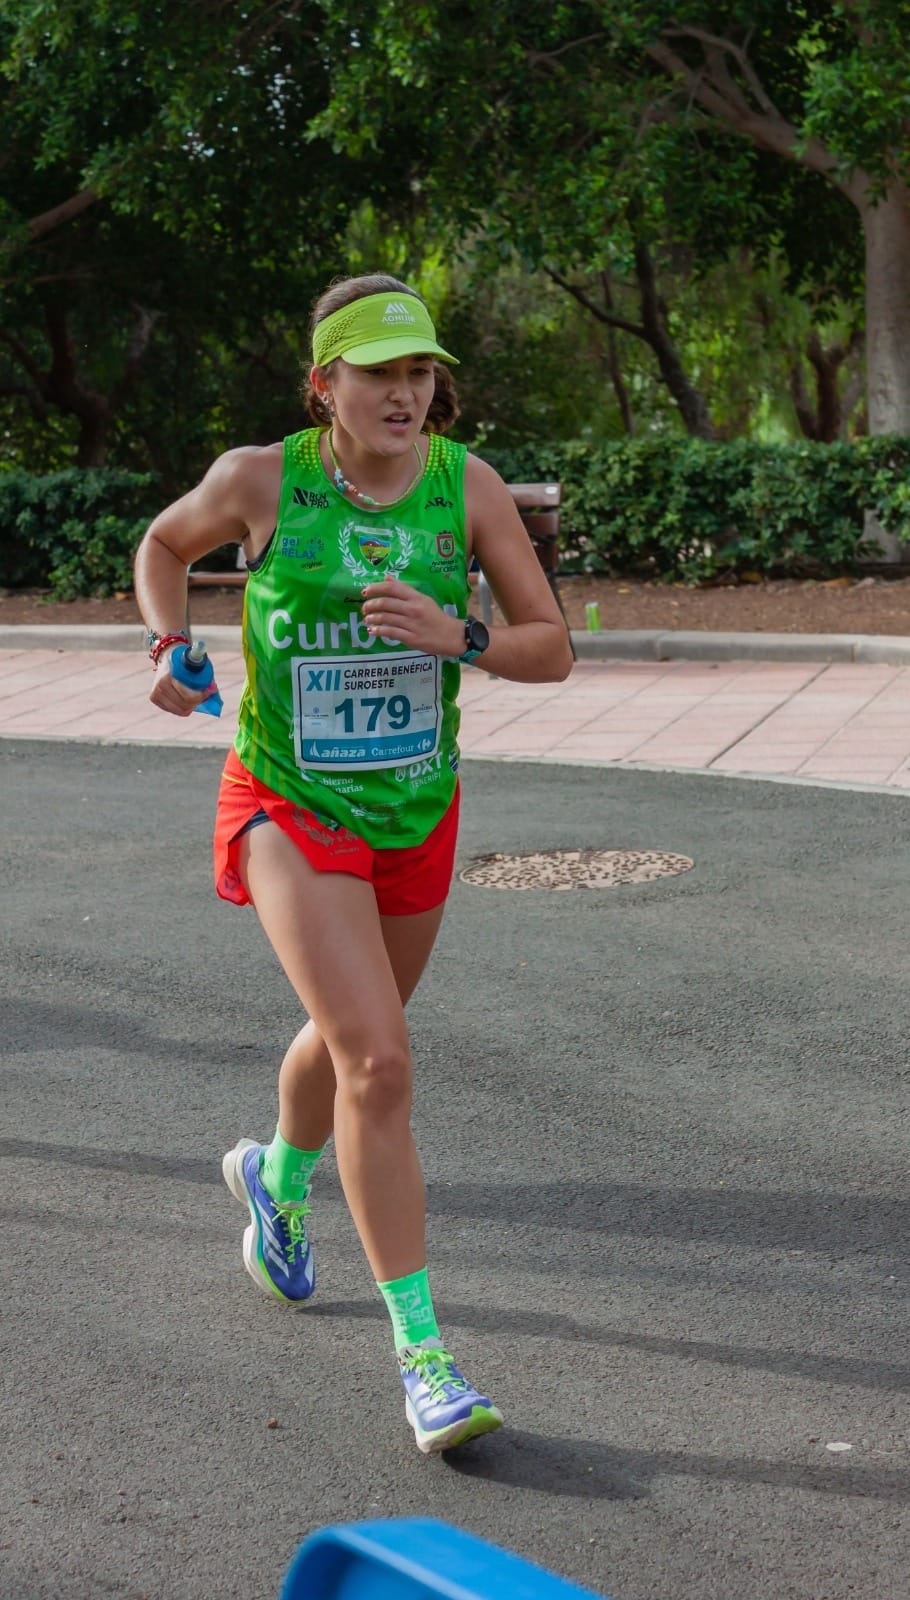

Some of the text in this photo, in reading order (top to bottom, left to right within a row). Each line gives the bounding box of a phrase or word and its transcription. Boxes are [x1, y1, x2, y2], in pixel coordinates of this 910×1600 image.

[311, 500, 329, 509] PRO
[282, 537, 298, 548] gel
[281, 547, 317, 560] RELAX
[305, 662, 433, 692] XII CARRERA BENÉFICA
[344, 679, 395, 691] SUROESTE
[334, 694, 411, 733] 179
[320, 745, 414, 758] añaza Carrefour
[410, 752, 442, 778] DXT
